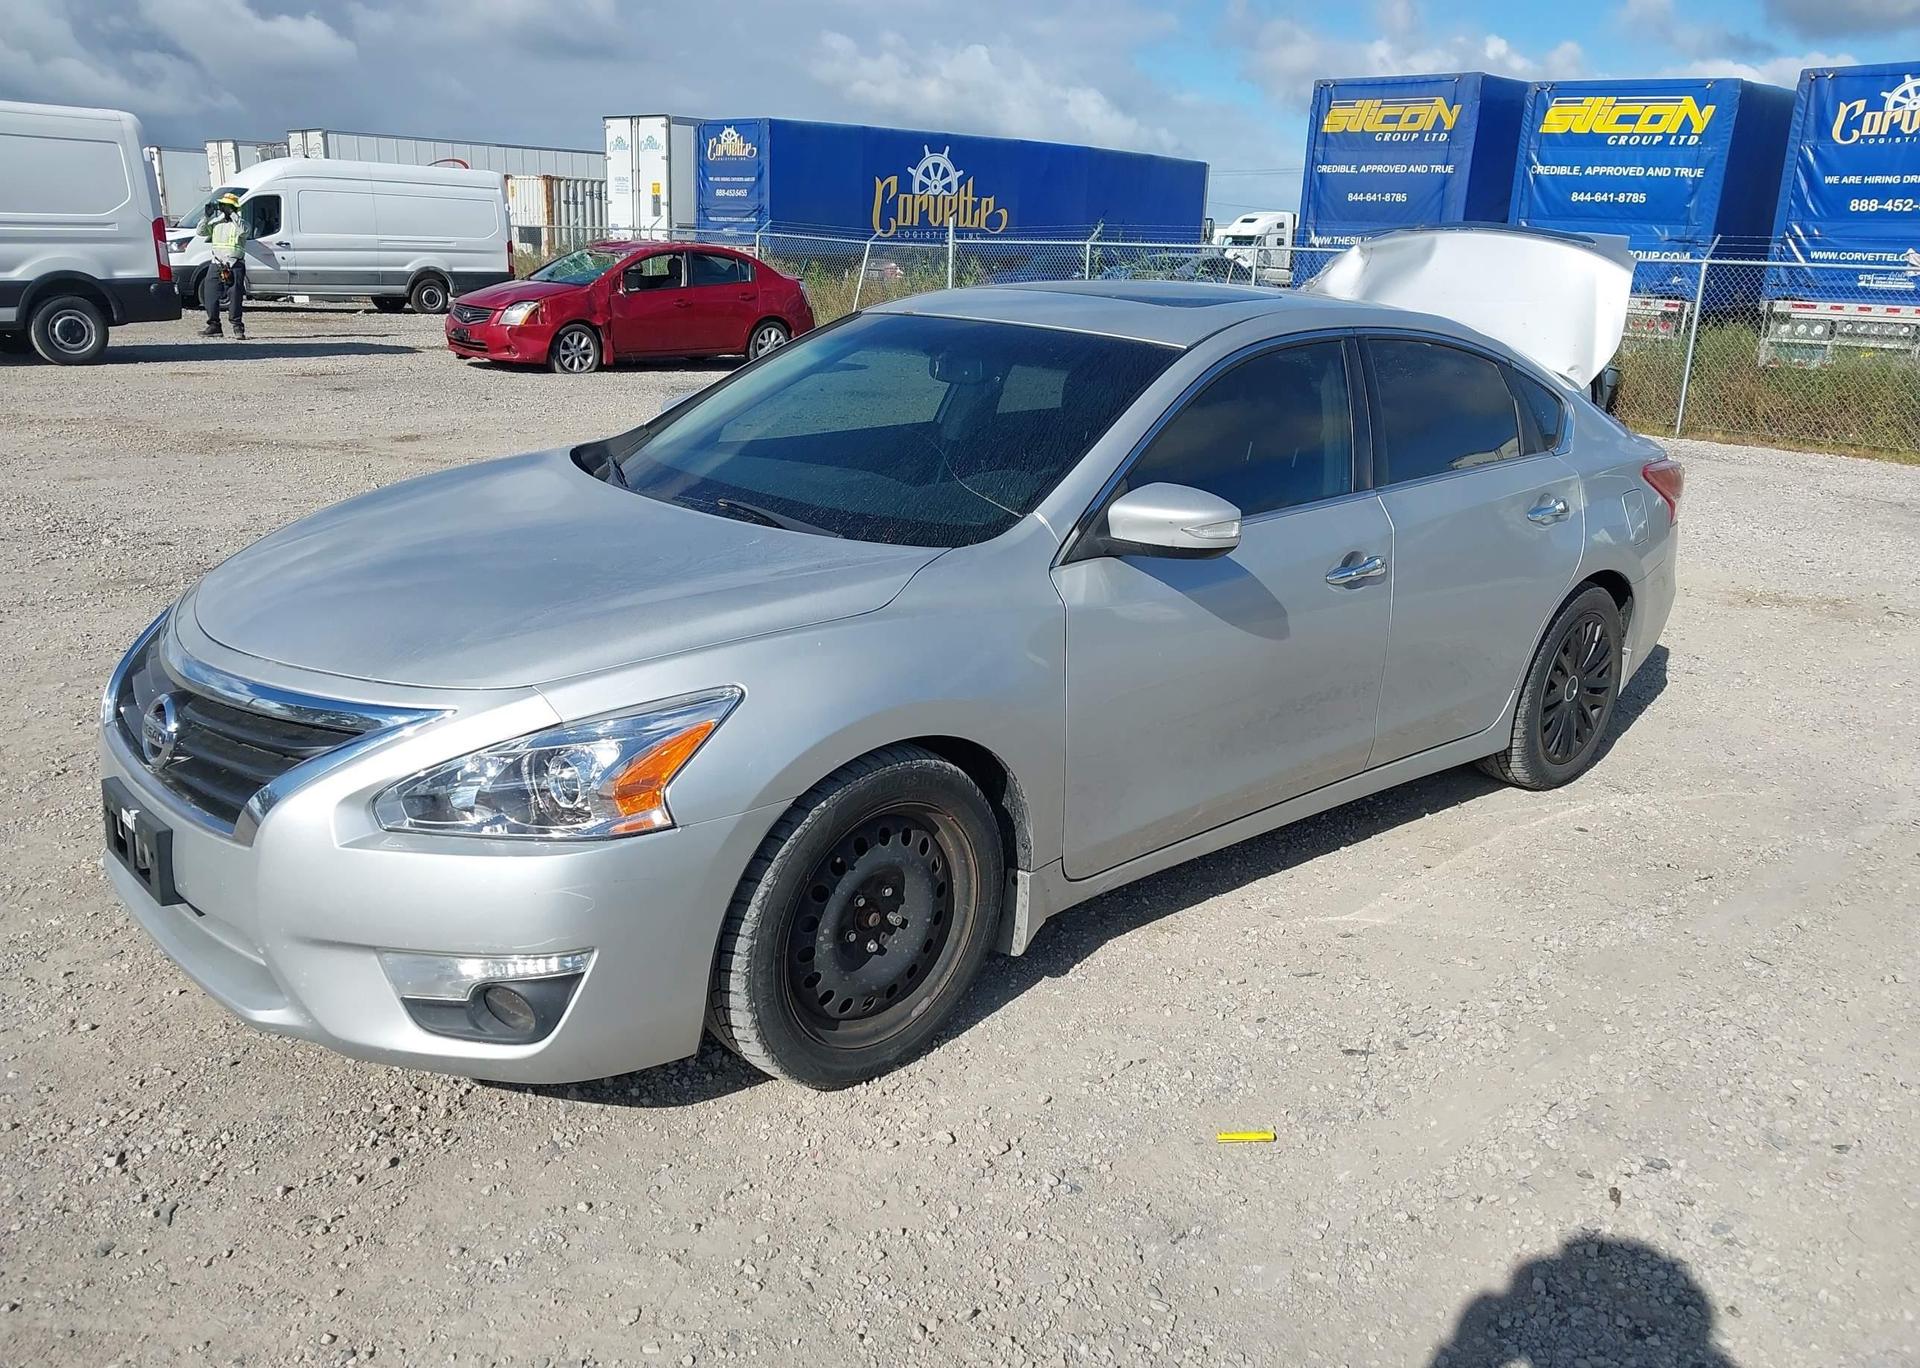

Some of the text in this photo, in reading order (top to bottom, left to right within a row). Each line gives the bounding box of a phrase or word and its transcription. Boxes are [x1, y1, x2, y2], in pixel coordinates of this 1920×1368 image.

[1375, 132, 1450, 142] GROUP LTD.
[1607, 135, 1703, 145] GROUP LTD.
[1317, 165, 1454, 174] CREDIBLE, APPROVED AND TRUE
[1531, 165, 1704, 178] CREDIBLE, APPROVED AND TRUE
[1824, 175, 1839, 184] WE
[1841, 175, 1862, 184] ARE
[1864, 175, 1900, 184] HIRING
[1347, 193, 1407, 202] 844-641-8785
[1571, 192, 1646, 204] 844-641-8785
[873, 175, 1008, 238] Corvette
[1849, 198, 1920, 211] 888-452-
